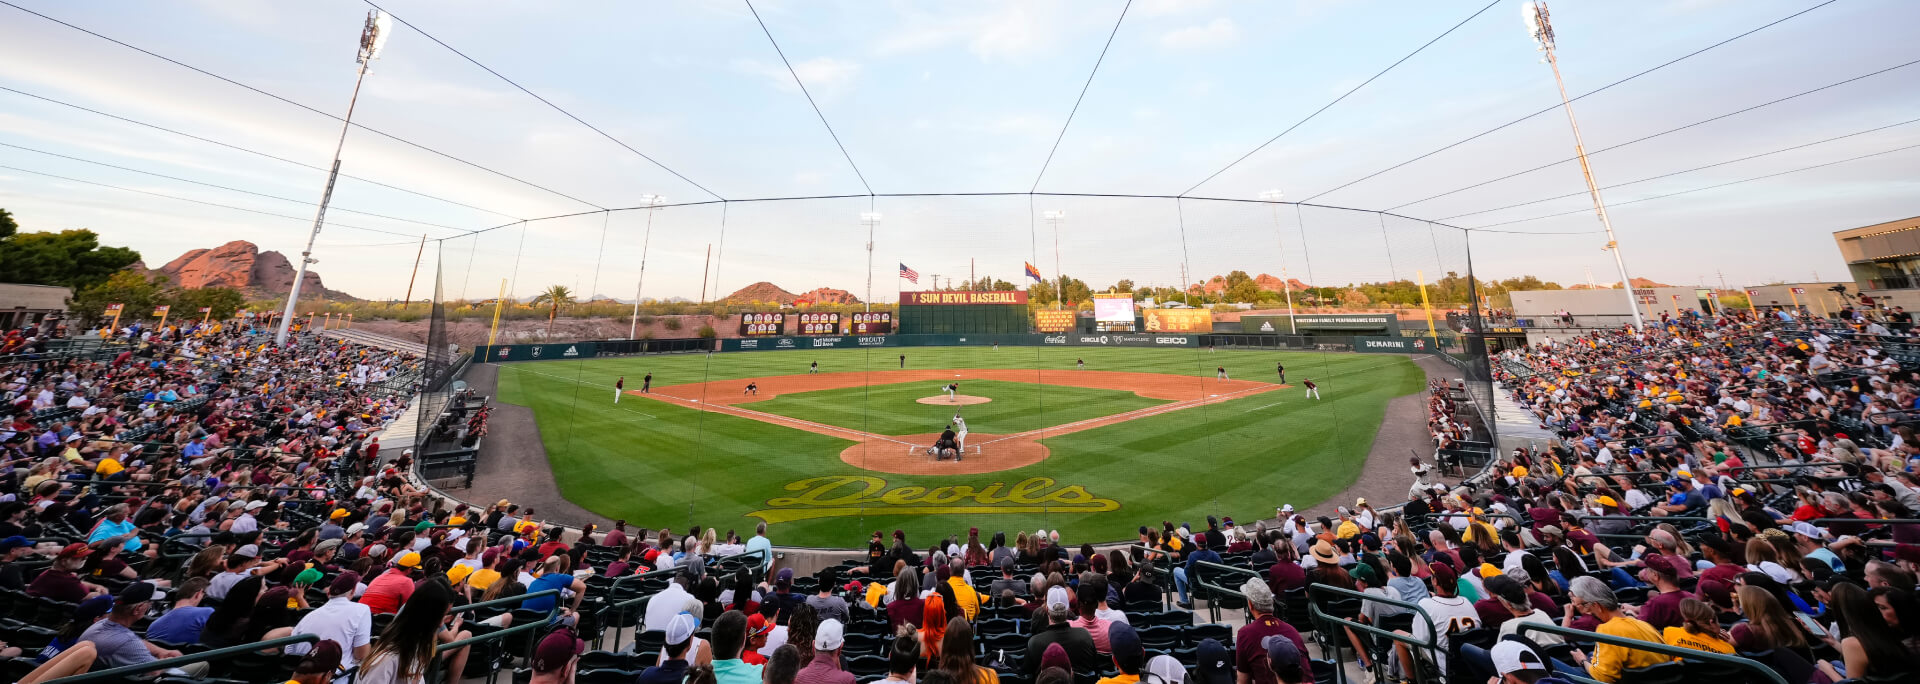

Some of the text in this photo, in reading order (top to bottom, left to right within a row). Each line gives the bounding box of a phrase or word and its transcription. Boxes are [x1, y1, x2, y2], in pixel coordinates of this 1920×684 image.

[920, 293, 1016, 303] SUN DEVIL BASEBALL
[765, 475, 1112, 512] Devils
